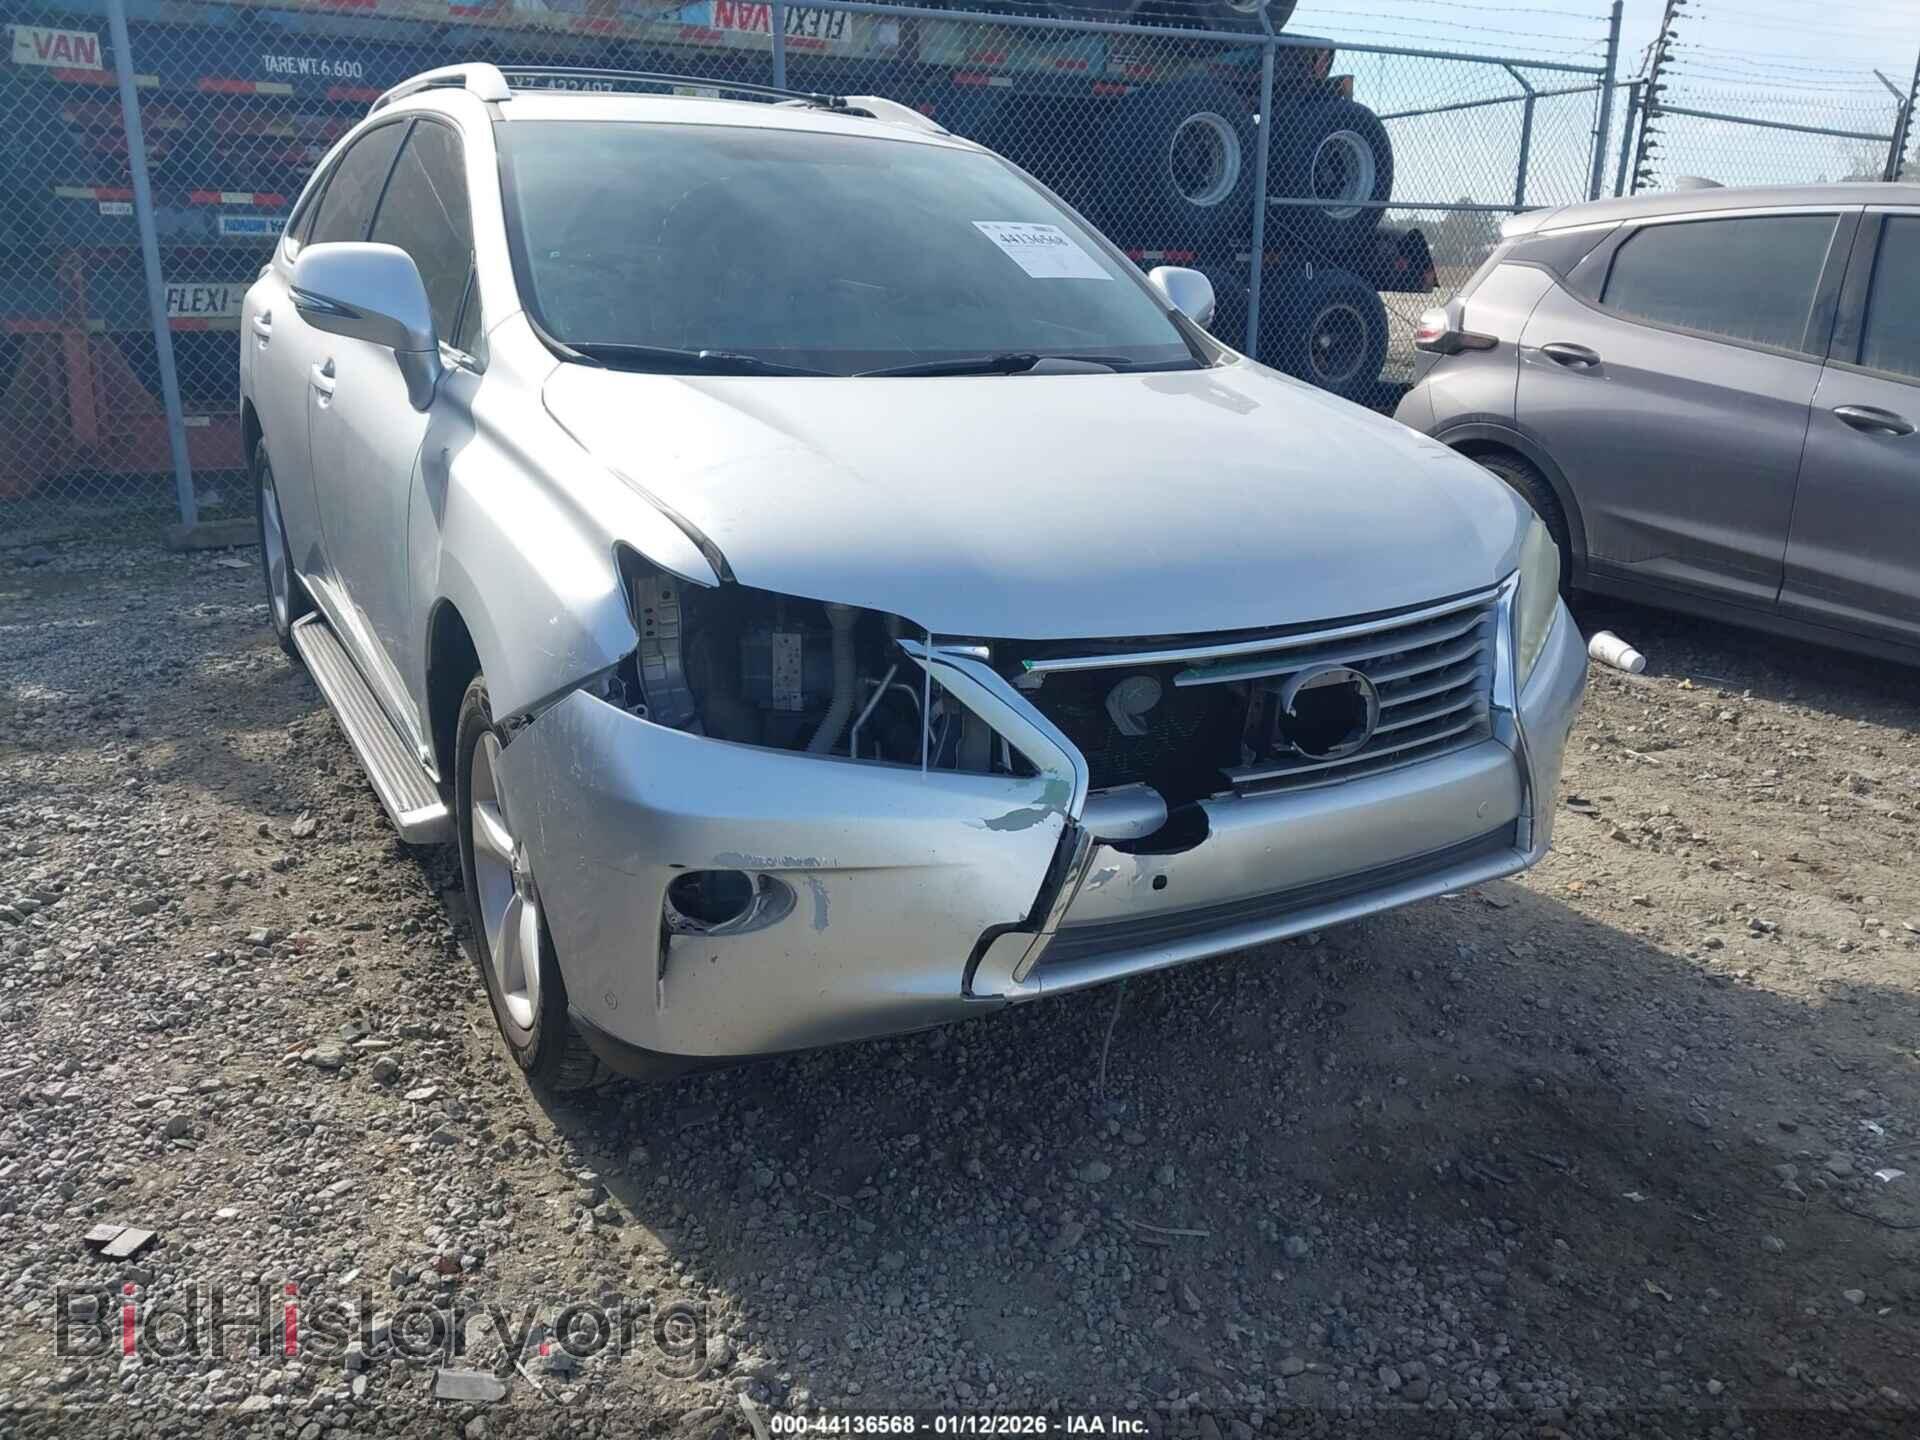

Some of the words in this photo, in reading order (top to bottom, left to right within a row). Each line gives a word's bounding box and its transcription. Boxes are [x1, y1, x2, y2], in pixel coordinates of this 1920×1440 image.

[713, 2, 770, 33] VAN
[262, 54, 297, 74] TARE
[321, 59, 362, 78] 6.600
